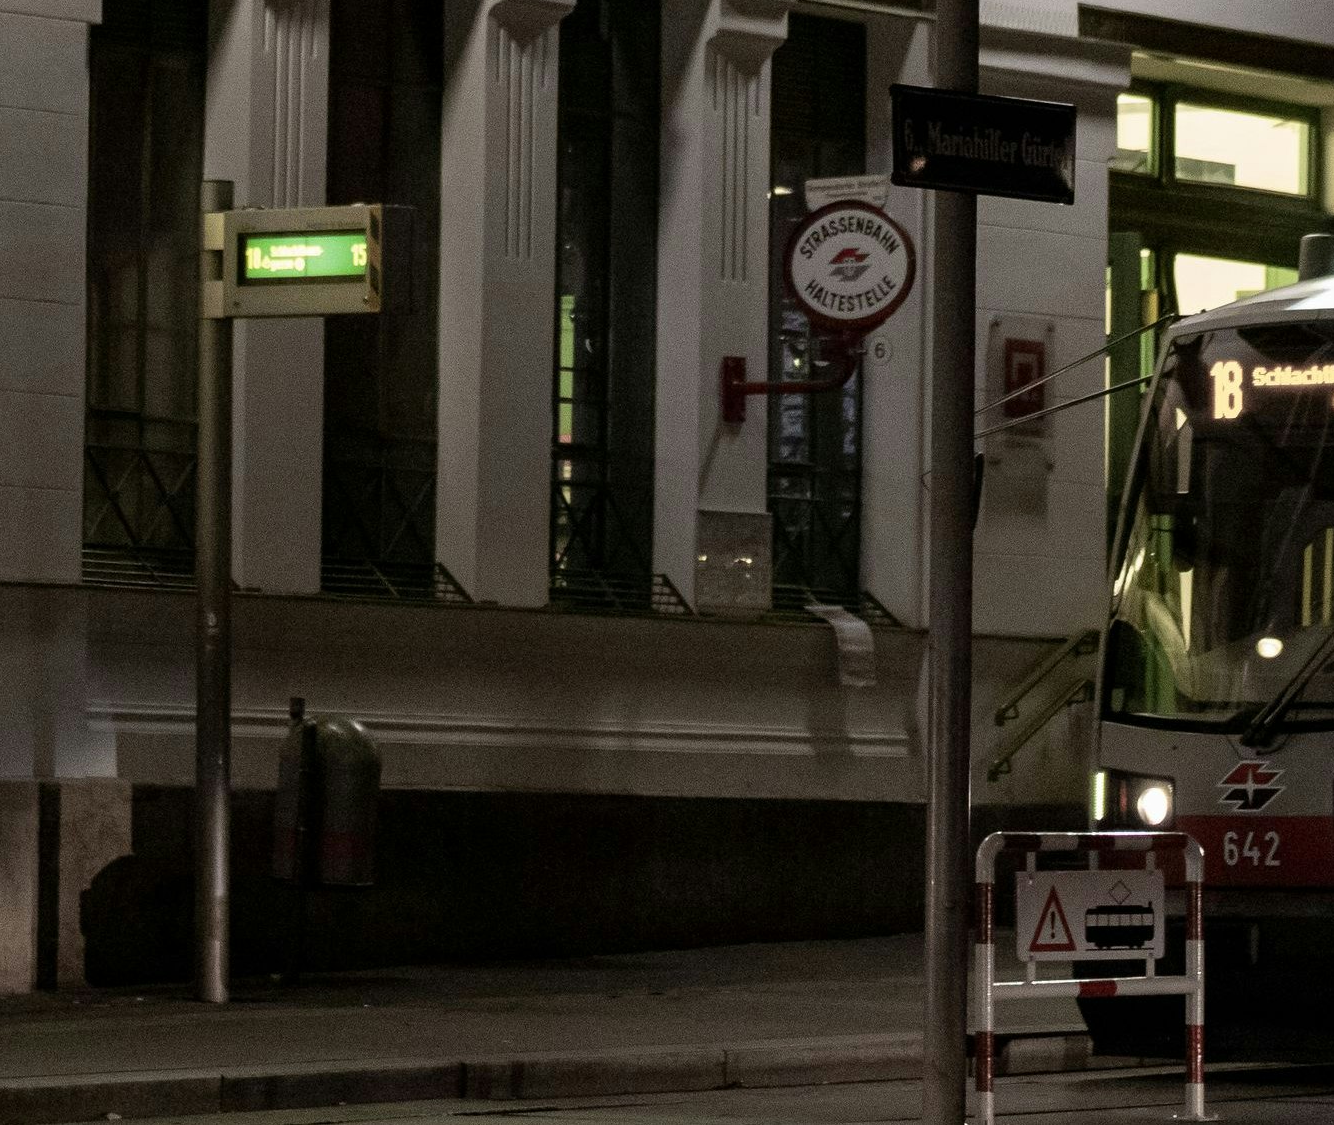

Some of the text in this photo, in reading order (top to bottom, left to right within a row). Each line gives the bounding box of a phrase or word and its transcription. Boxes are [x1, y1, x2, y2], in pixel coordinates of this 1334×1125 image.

[926, 120, 1017, 165] Mariahilfer
[1020, 130, 1069, 172] Gürte
[351, 242, 367, 267] 15
[799, 216, 900, 259] STRASSENBAHN
[805, 275, 896, 312] HALTESTELLE
[874, 342, 885, 359] 6
[1209, 360, 1244, 420] 18
[1223, 831, 1282, 868] 642
